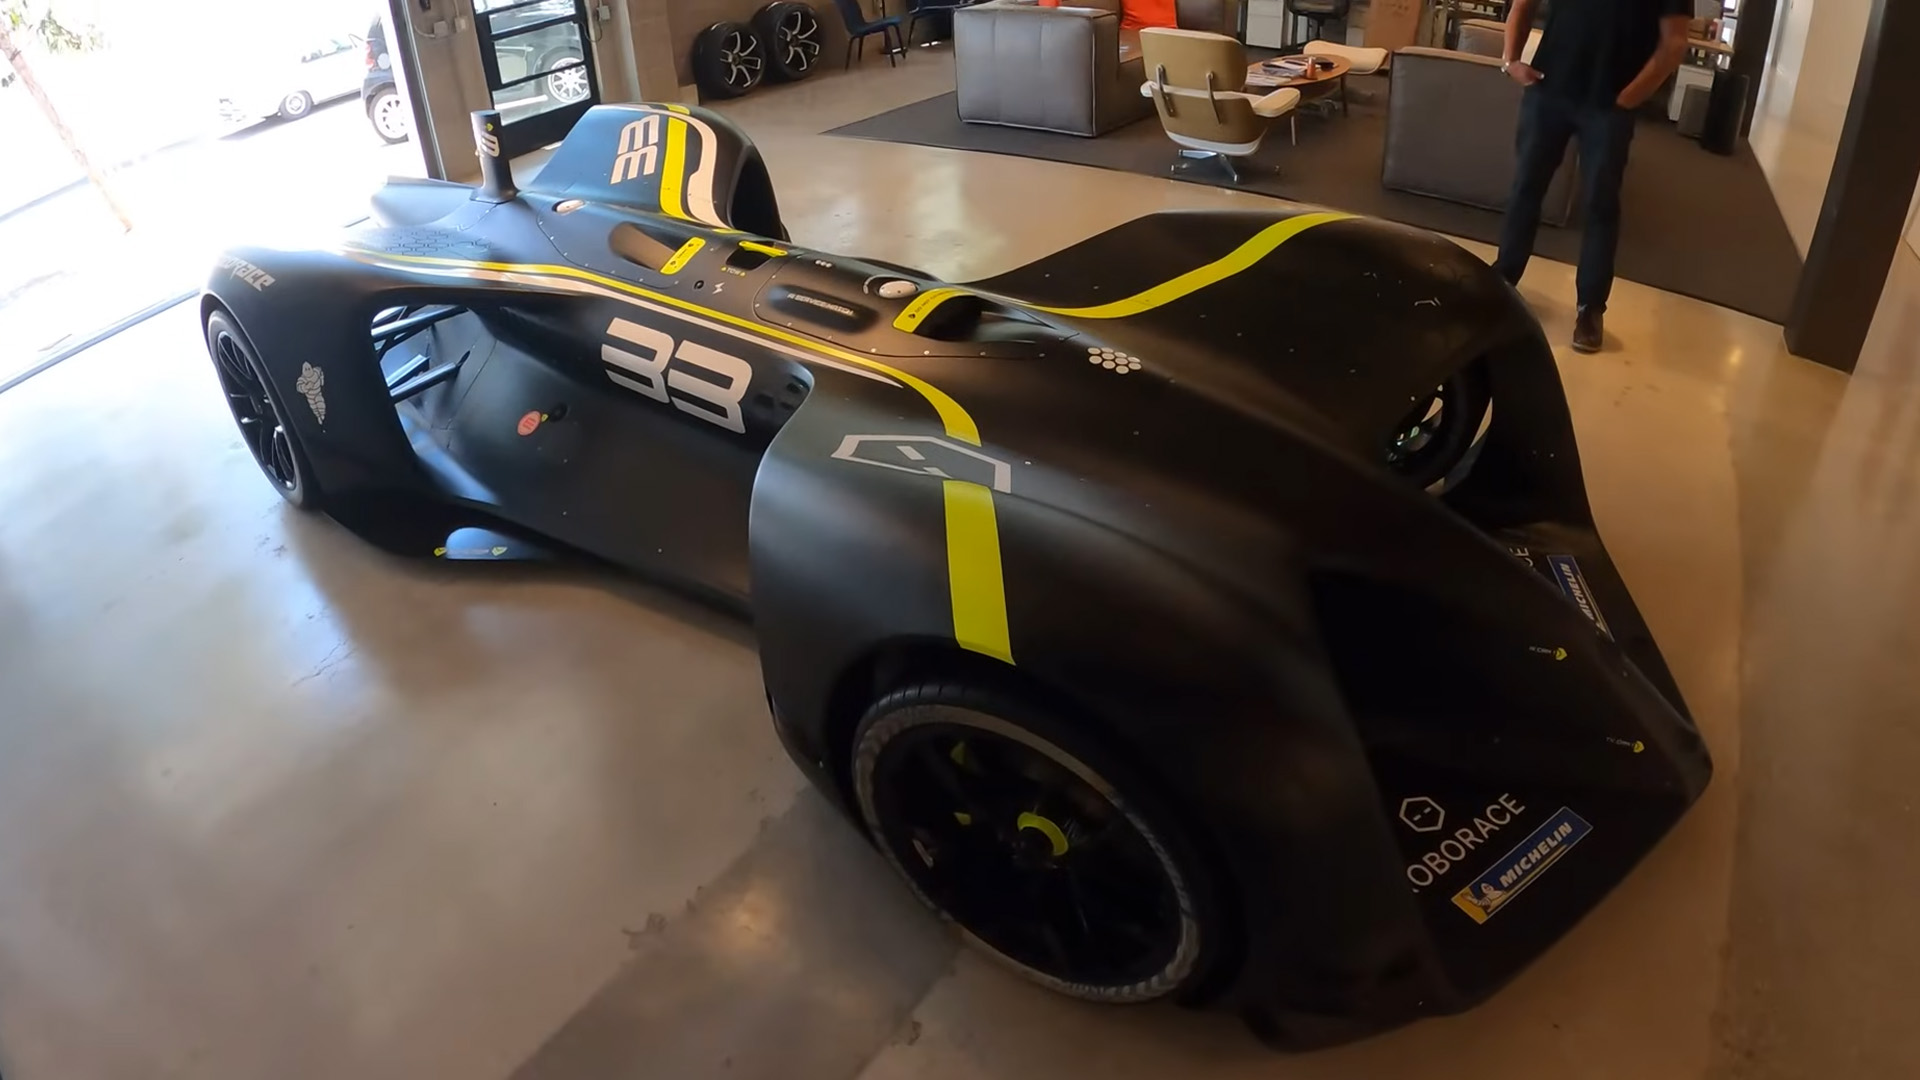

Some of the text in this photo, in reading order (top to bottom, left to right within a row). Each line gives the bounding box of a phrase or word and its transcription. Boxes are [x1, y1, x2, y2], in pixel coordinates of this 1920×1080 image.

[611, 115, 660, 184] 33
[601, 317, 752, 434] 33
[1559, 562, 1595, 621] MICHELIN
[1407, 793, 1526, 893] OBORACE
[1499, 822, 1573, 888] MICHELIN
